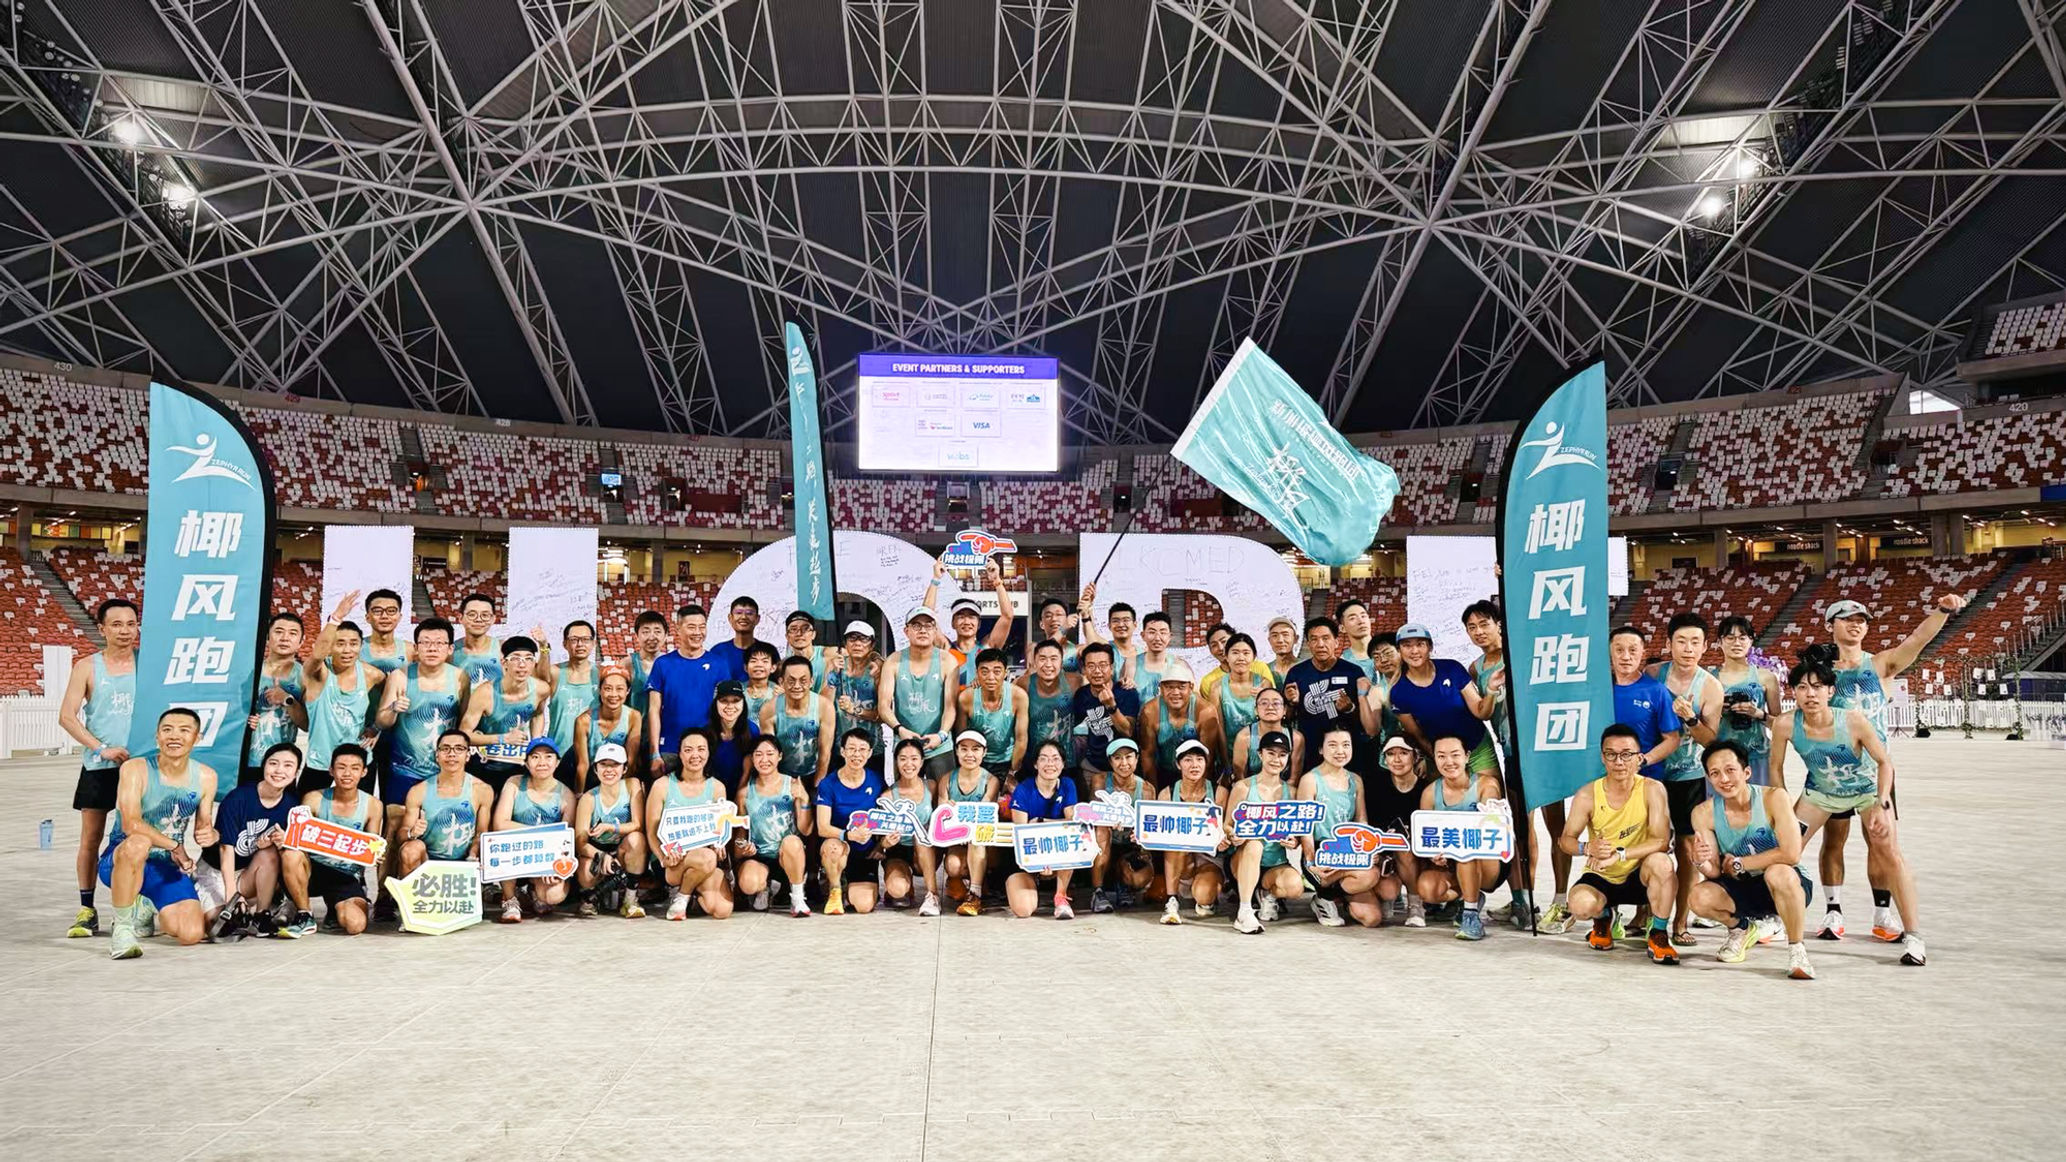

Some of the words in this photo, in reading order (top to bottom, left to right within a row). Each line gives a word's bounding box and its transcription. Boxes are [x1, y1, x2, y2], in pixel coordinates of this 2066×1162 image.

[54, 361, 73, 372] 430
[892, 363, 919, 373] EVENT
[920, 364, 962, 374] PARTNERS
[964, 365, 970, 373] &
[972, 365, 1025, 375] SUPPORTERS
[2009, 402, 2028, 412] 420
[1524, 498, 1591, 752] 椰风跑团
[957, 804, 995, 824] 我要
[975, 824, 1014, 844] 破三
[1142, 814, 1209, 835] 最帅椰子
[1237, 819, 1312, 837] 全力以赴!
[300, 824, 368, 856] 破三起步
[489, 839, 544, 854] 你跑过的路
[1023, 834, 1084, 856] 最帅椰子
[1420, 826, 1503, 851] 最美椰子
[1318, 851, 1370, 868] 挑战极限
[412, 873, 477, 899] 必胜!
[412, 899, 475, 915] 全力以赴
